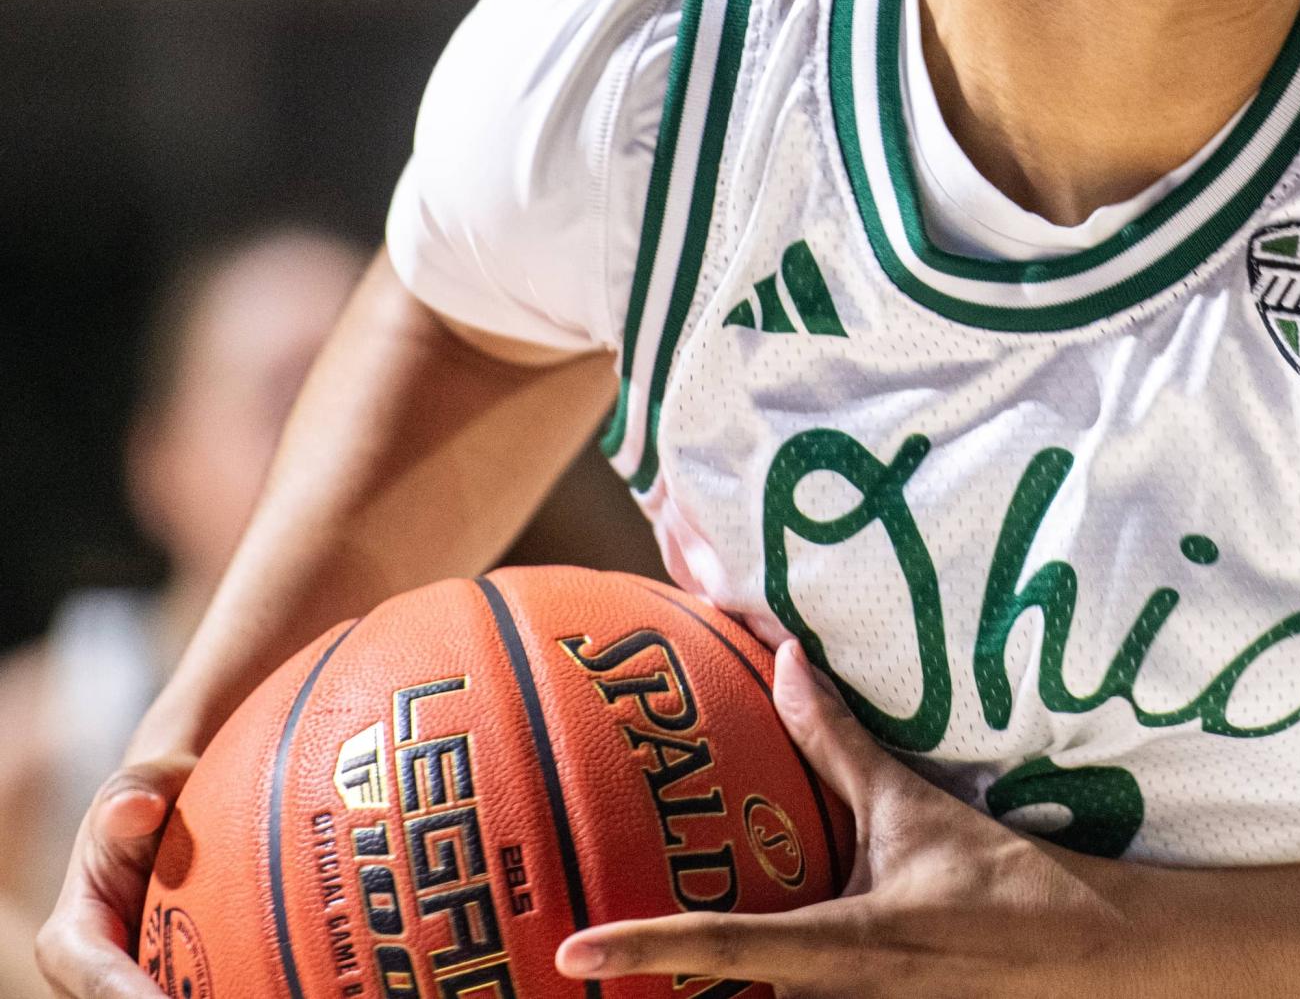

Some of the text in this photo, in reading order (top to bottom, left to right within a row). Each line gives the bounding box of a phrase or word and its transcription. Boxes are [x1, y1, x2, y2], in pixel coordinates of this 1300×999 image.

[311, 811, 345, 912] OFFICIAL
[328, 914, 361, 979] GAME
[556, 628, 756, 999] SPALD
